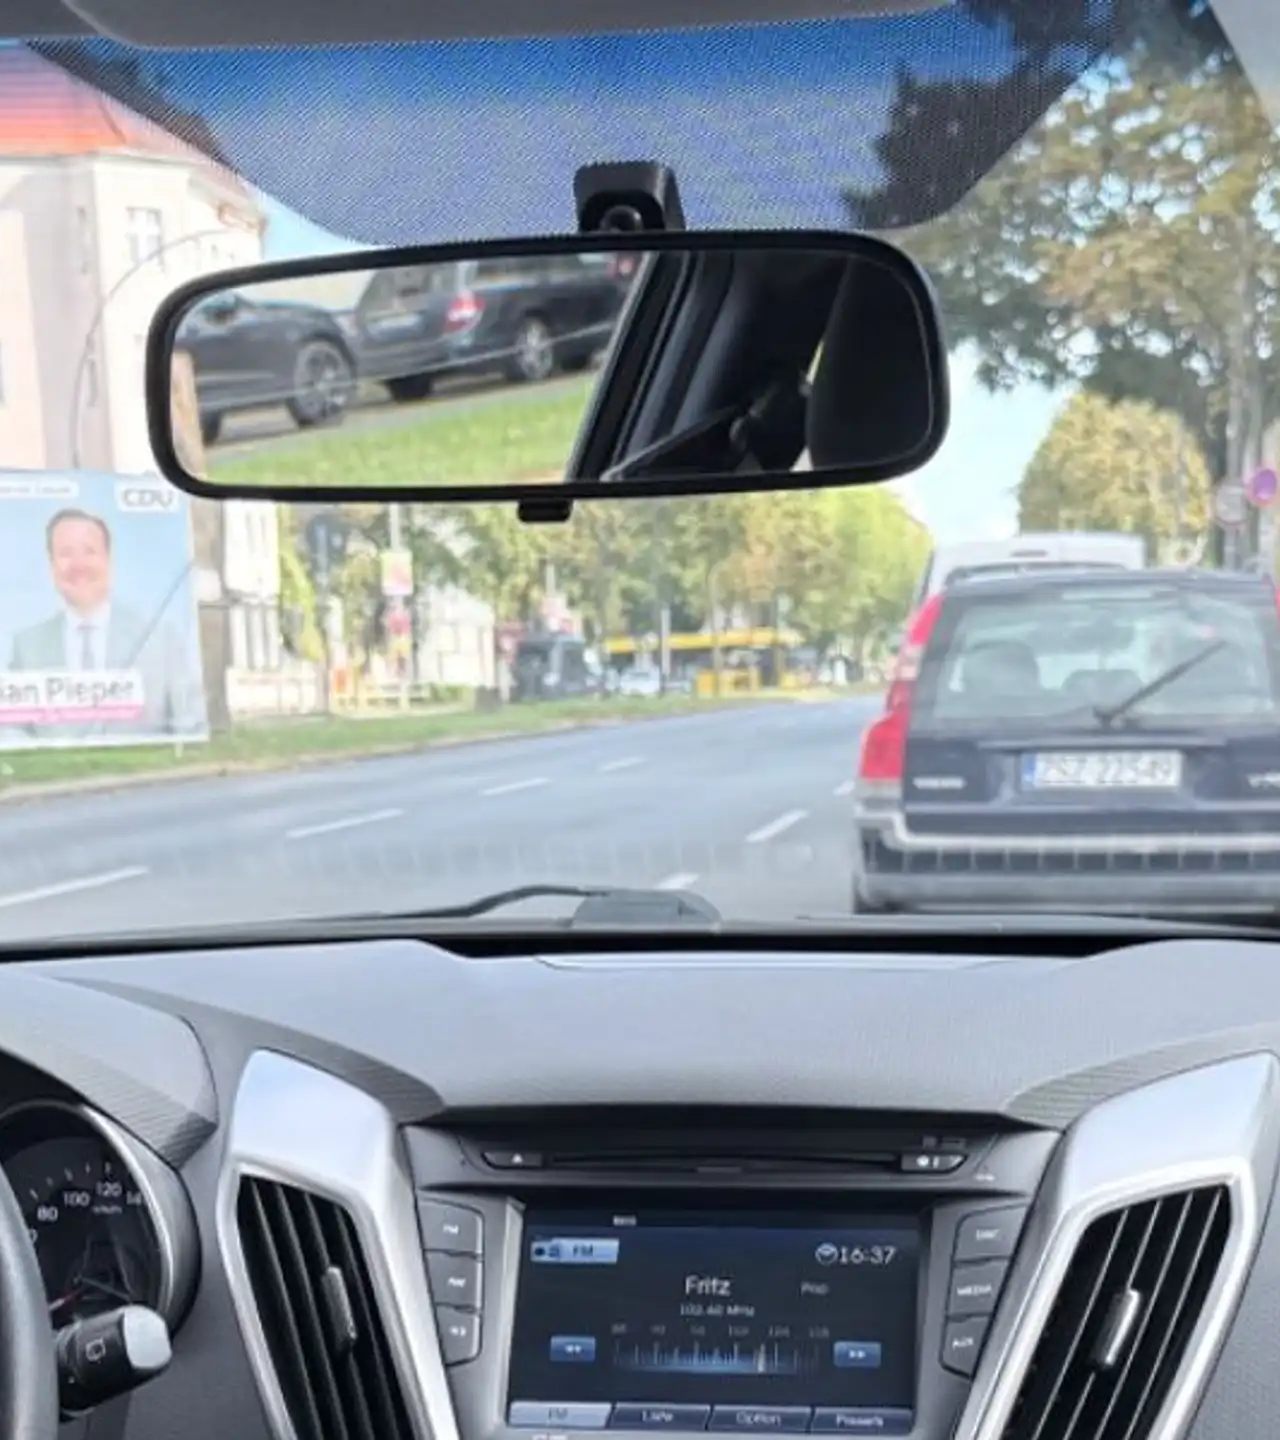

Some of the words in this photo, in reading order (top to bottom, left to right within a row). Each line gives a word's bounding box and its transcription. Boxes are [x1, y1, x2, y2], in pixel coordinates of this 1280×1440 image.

[122, 488, 174, 509] CDU
[45, 676, 135, 706] Pieper
[95, 1182, 122, 1196] 120
[63, 1191, 90, 1207] 100
[37, 1206, 58, 1222] 80
[839, 1245, 897, 1264] 16:37
[685, 1275, 731, 1296] Fritz
